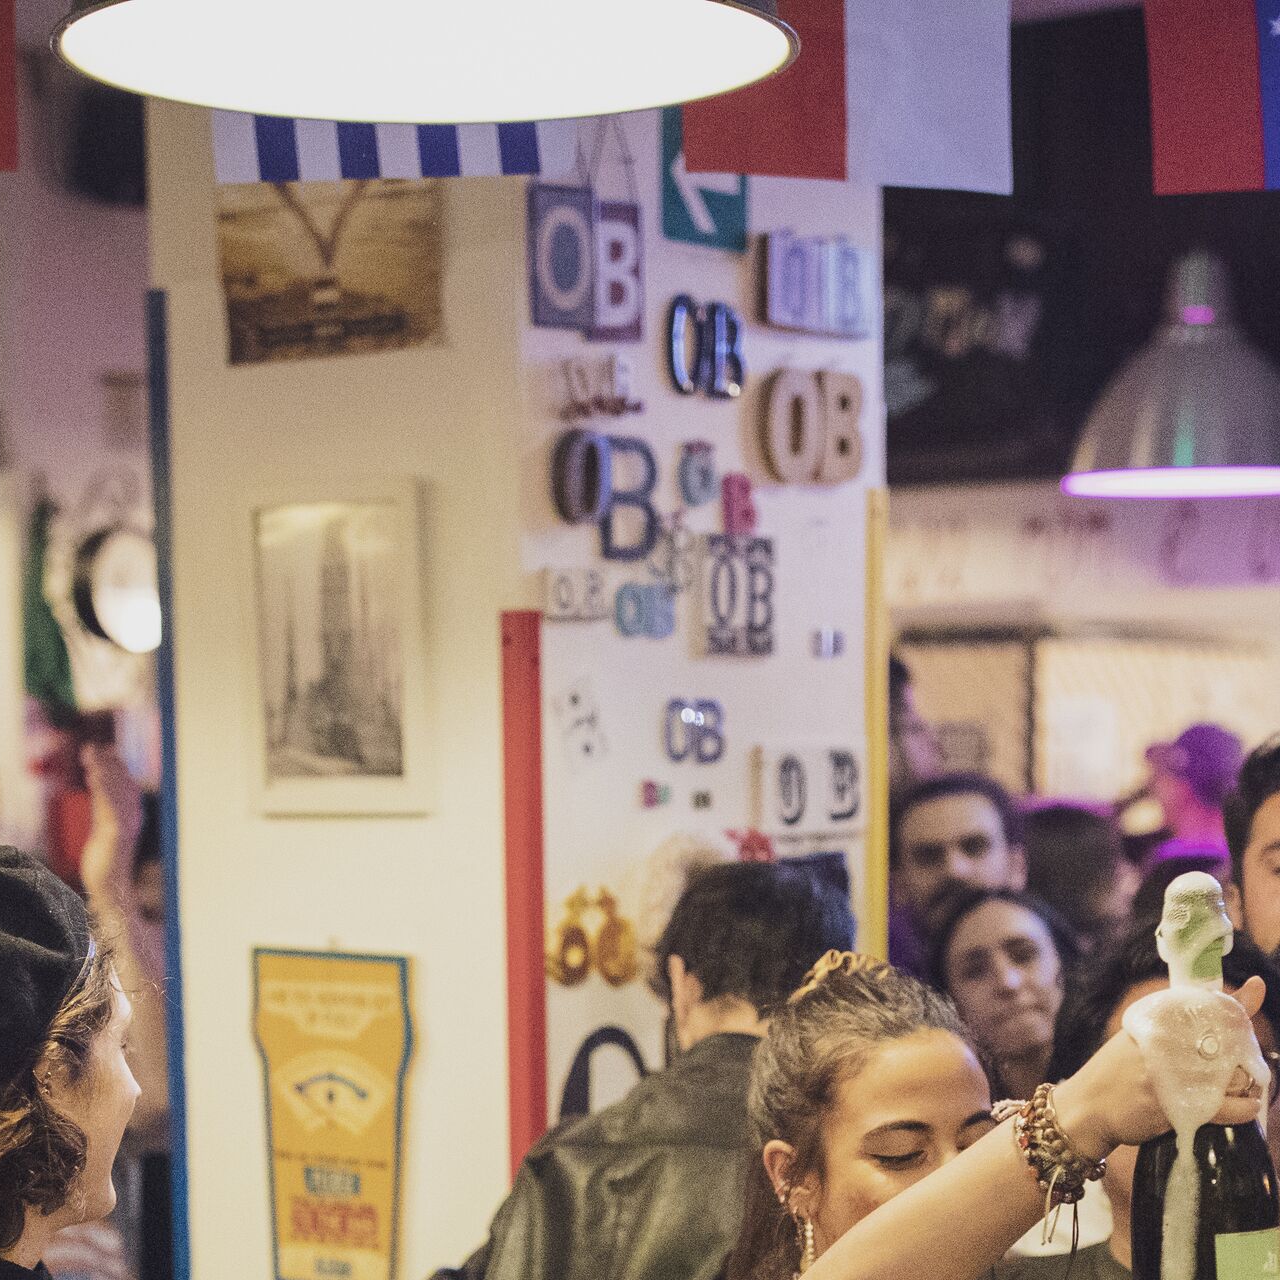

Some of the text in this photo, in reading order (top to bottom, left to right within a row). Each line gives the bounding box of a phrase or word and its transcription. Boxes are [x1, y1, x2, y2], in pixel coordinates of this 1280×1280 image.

[535, 203, 640, 328] OB
[668, 293, 747, 399] OB
[756, 367, 864, 487] OB
[549, 427, 660, 562] OB
[663, 697, 726, 766] OB
